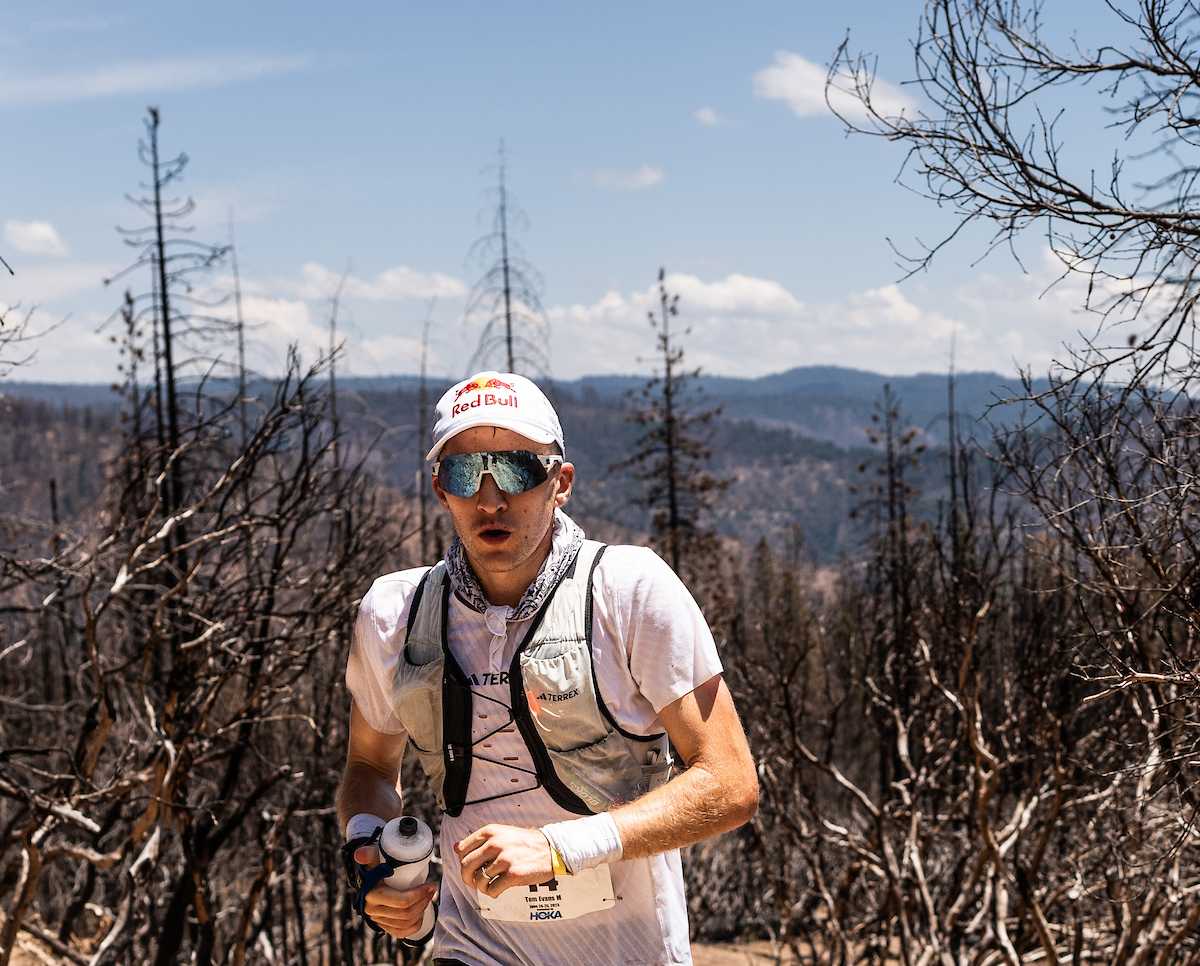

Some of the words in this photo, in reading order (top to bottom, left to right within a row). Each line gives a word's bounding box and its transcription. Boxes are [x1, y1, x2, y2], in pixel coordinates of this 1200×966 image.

[452, 394, 481, 418] Red
[485, 394, 518, 408] Bull
[482, 671, 510, 686] TER
[548, 688, 579, 702] TERREX
[530, 911, 562, 920] HOKA
